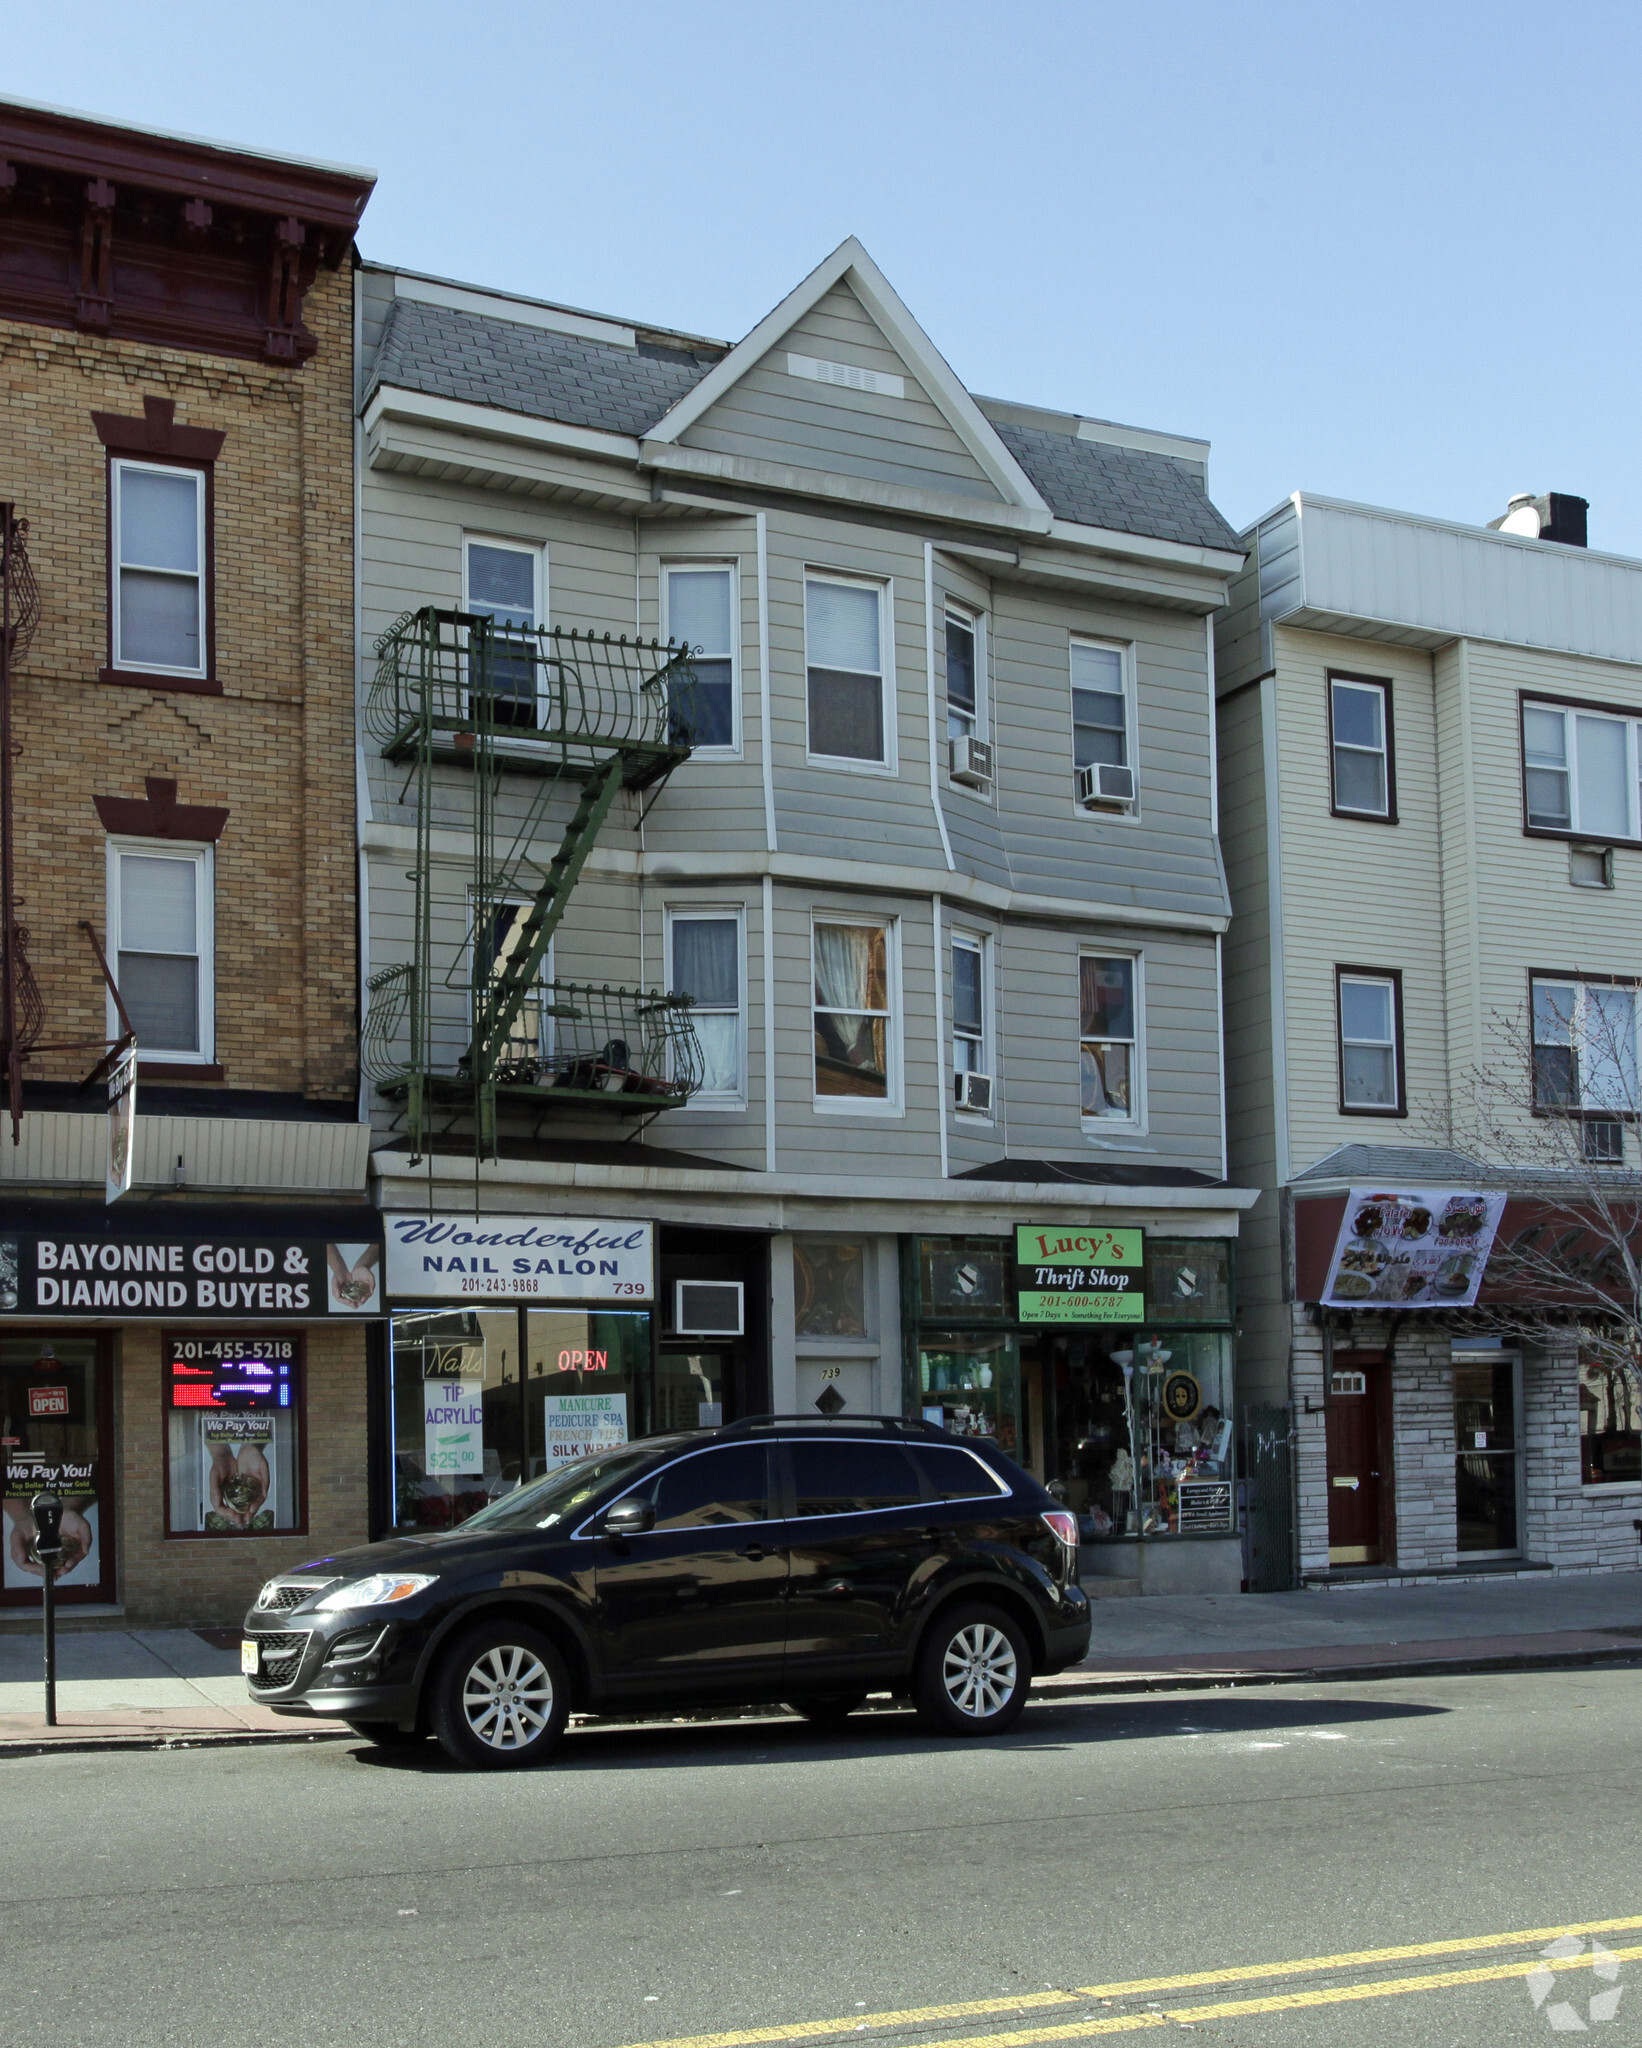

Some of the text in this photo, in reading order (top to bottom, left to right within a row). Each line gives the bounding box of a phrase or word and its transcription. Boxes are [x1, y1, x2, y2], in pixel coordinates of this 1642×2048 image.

[394, 1220, 645, 1256] Wonderful
[1035, 1232, 1124, 1260] Lucy's
[37, 1241, 309, 1274] BAYONNE GOLD &
[423, 1256, 618, 1276] NAIL SALON
[1035, 1268, 1130, 1291] Thrift Shop
[36, 1277, 310, 1309] DIAMOND BUYERS
[612, 1283, 645, 1295] 739
[1040, 1296, 1123, 1308] 201-600-6787
[1022, 1311, 1038, 1320] Open
[1046, 1311, 1061, 1320] Days
[173, 1342, 292, 1359] 201-455-5218
[426, 1342, 483, 1374] Nails
[558, 1350, 608, 1371] OPEN
[822, 1368, 840, 1380] 739
[33, 1398, 64, 1412] OPEN
[559, 1398, 612, 1412] MANICURE
[207, 1420, 270, 1432] We Pay You!
[549, 1413, 624, 1428] PEDICURE SPA
[549, 1428, 624, 1441] FRENCH TIPS
[553, 1444, 579, 1457] SILK
[6, 1464, 92, 1480] We Pay You!
